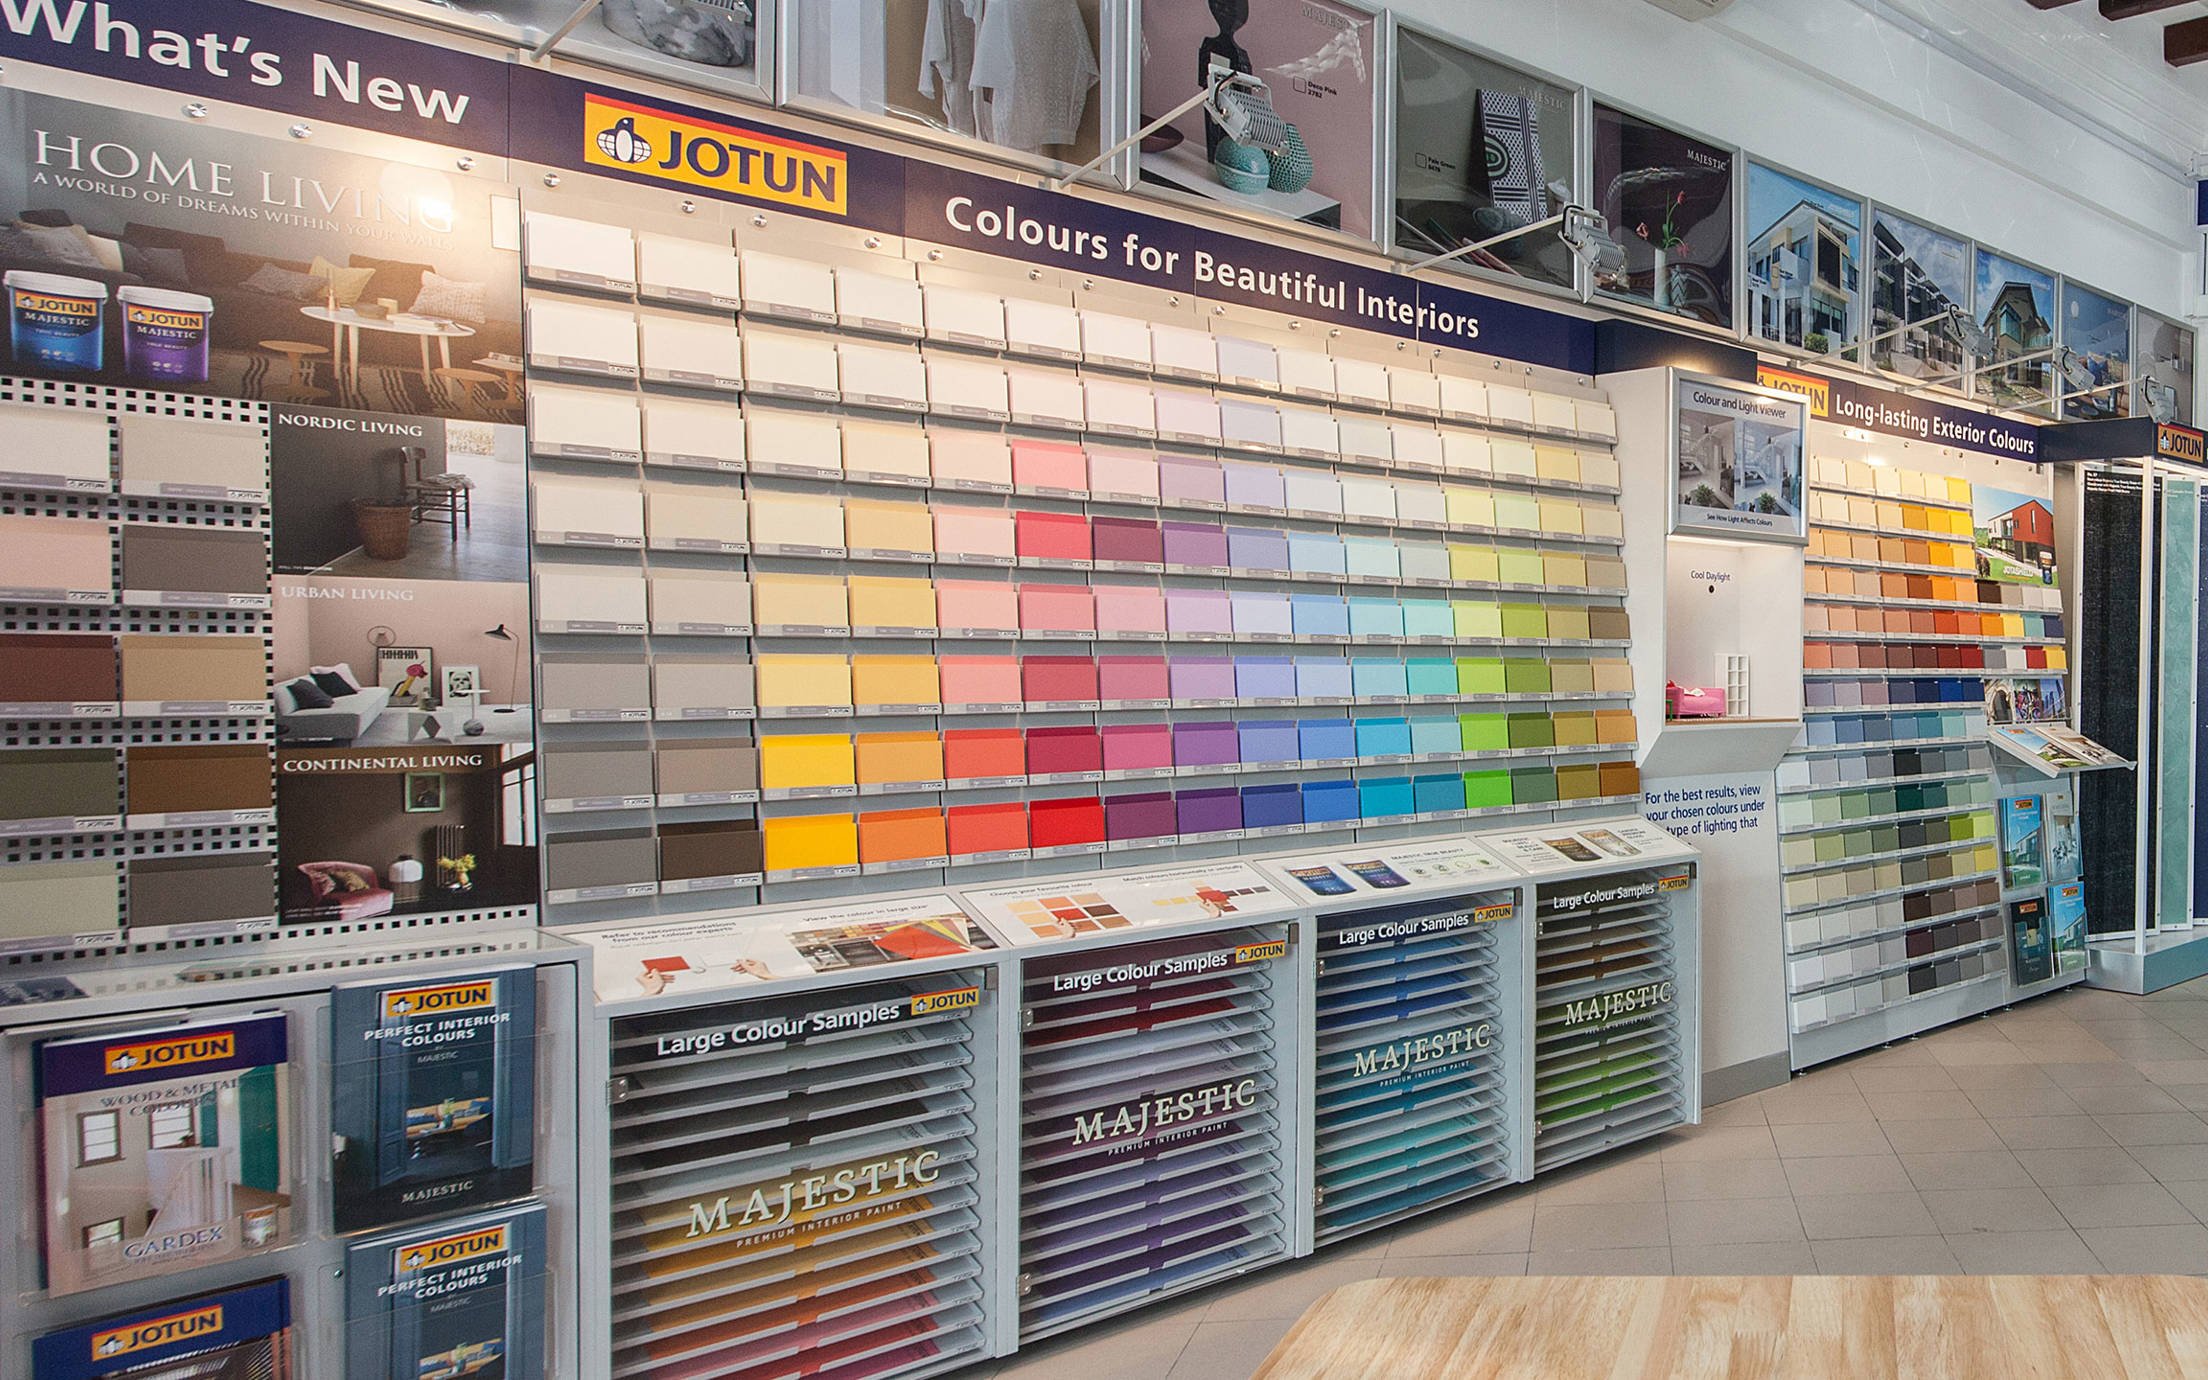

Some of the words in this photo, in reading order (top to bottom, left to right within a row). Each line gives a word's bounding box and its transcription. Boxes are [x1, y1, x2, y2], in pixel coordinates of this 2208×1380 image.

[0, 0, 283, 87] What's
[313, 52, 470, 125] New
[657, 130, 836, 203] JOTUN
[1686, 148, 1727, 172] MAJESTIC
[34, 129, 235, 197] HOME
[259, 169, 453, 234] LIVING
[33, 172, 48, 185] A
[55, 174, 138, 200] WORLD
[143, 190, 172, 205] OF
[178, 195, 259, 220] DREAMS
[264, 209, 340, 232] WITHIN
[945, 196, 1108, 260] Colours
[1122, 233, 1179, 275] for
[1194, 250, 1346, 311] Beautiful
[1358, 286, 1480, 339] Interiors
[24, 312, 91, 327] MAJESTIC
[38, 298, 94, 314] JOTUN
[150, 312, 200, 328] JOTUN
[136, 325, 197, 339] MAJESTIC
[1693, 391, 1720, 410] Colour
[1722, 398, 1738, 410] and
[1738, 400, 1759, 414] Light
[278, 413, 356, 432] NORDIC
[361, 420, 423, 437] LIVING
[1836, 394, 1928, 438] Long-lasting
[1933, 416, 1986, 444] Exterior
[1988, 428, 2034, 454] Colours
[2170, 433, 2202, 458] JOTUN
[1690, 570, 1704, 580] Cool
[1706, 571, 1730, 583] Daylight
[280, 586, 345, 600] URBAN
[352, 588, 414, 601] LIVING
[282, 756, 418, 772] CONTINENTAL
[422, 754, 483, 768] LIVING
[1645, 792, 1661, 804] For
[1664, 790, 1680, 803] the
[1682, 788, 1703, 801] best
[1705, 785, 1738, 799] results,
[1739, 784, 1760, 796] view
[1670, 806, 1704, 820] chosen
[1706, 802, 1738, 816] colours
[1740, 799, 1766, 812] under
[1691, 821, 1702, 834] of
[1704, 817, 1738, 836] lighting
[1740, 816, 1758, 829] that
[1553, 896, 1582, 910] Large
[1584, 889, 1616, 906] Colour
[1617, 882, 1655, 900] Samples
[1666, 880, 1688, 890] JOTUN
[1484, 906, 1511, 918] JOTUN
[602, 932, 630, 940] Refer
[648, 921, 737, 935] recommendations
[1339, 931, 1376, 946] Large
[1378, 922, 1418, 939] Colour
[1421, 913, 1470, 932] Samples
[1249, 944, 1284, 959] JOTUN
[1054, 974, 1102, 992] Large
[1106, 962, 1162, 983] Colour
[1164, 953, 1228, 974] Samples
[415, 988, 487, 1011] JOTUN
[928, 990, 976, 1010] JOTUN
[1564, 982, 1672, 1026] MAJESTIC
[364, 1022, 433, 1041] PERFECT
[438, 1012, 511, 1032] INTERIOR
[401, 1028, 476, 1048] COLOURS
[656, 1032, 726, 1056] Large
[731, 1014, 808, 1044] Colour
[812, 1004, 900, 1032] Samples
[141, 1038, 229, 1066] JOTUN
[1354, 1024, 1491, 1078] MAJESTIC
[1380, 1075, 1412, 1088] PREMIUM
[1414, 1066, 1448, 1079] INTERIOR
[1450, 1060, 1470, 1070] PAINT
[101, 1090, 161, 1108] WOOD
[164, 1087, 178, 1098] &
[182, 1078, 240, 1096] METAL
[1072, 1079, 1256, 1146] MAJESTIC
[1108, 1140, 1152, 1157] PREMIUM
[1155, 1128, 1198, 1145] INTERIOR
[1202, 1122, 1228, 1134] PAINT
[401, 1180, 474, 1204] MAJESTIC
[686, 1150, 940, 1238] MAJESTIC
[736, 1226, 796, 1248] PREMIUM
[802, 1211, 861, 1232] INTERIOR
[866, 1202, 902, 1217] PAINT
[123, 1226, 224, 1259] GARDEX
[428, 1233, 500, 1263] JOTUN
[377, 1271, 448, 1297] PERFECT
[450, 1254, 523, 1280] INTERIOR
[414, 1273, 488, 1300] COLOURS
[127, 1311, 217, 1349] JOTUN
